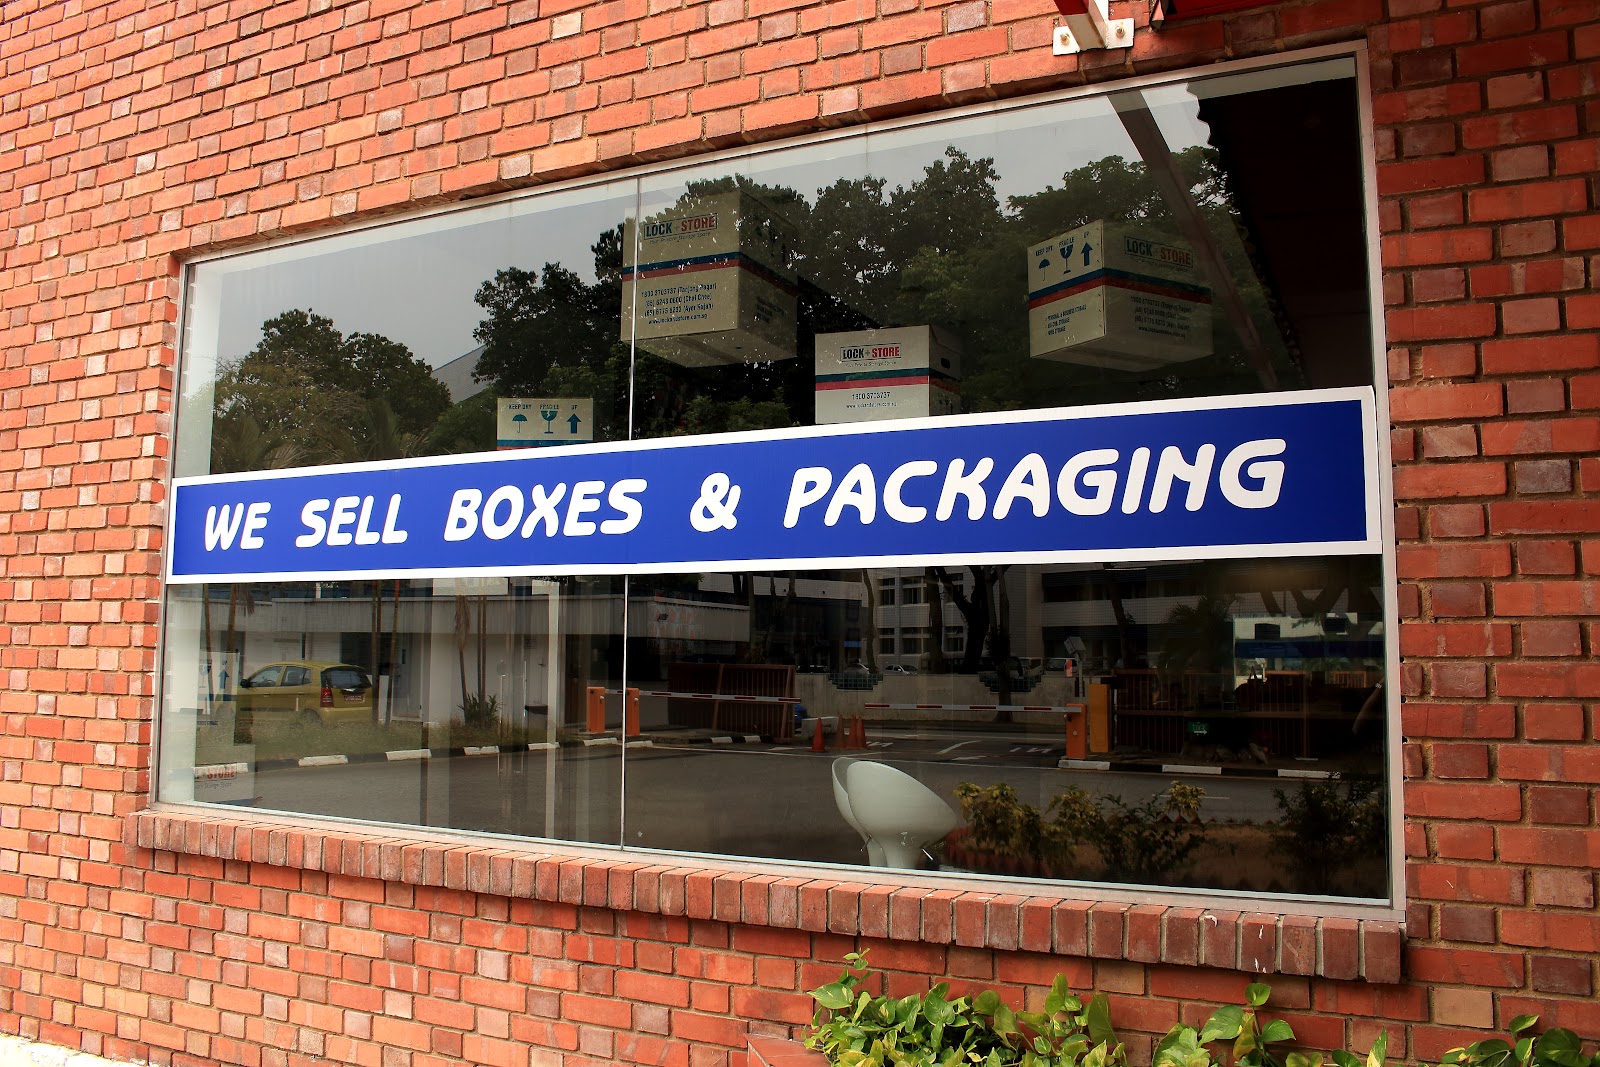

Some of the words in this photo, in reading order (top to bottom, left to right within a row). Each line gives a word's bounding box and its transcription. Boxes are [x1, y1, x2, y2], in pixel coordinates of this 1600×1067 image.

[646, 222, 672, 237] LOCK
[681, 216, 715, 232] STORE
[1126, 239, 1153, 256] LOCK
[1160, 247, 1191, 265] STORE
[843, 348, 865, 359] LOCK
[872, 346, 900, 358] STORE
[205, 502, 271, 551] WE
[295, 494, 408, 549] SELL
[444, 479, 648, 541] BOXES
[689, 473, 741, 533] &
[783, 438, 1286, 528] PACKAGING
